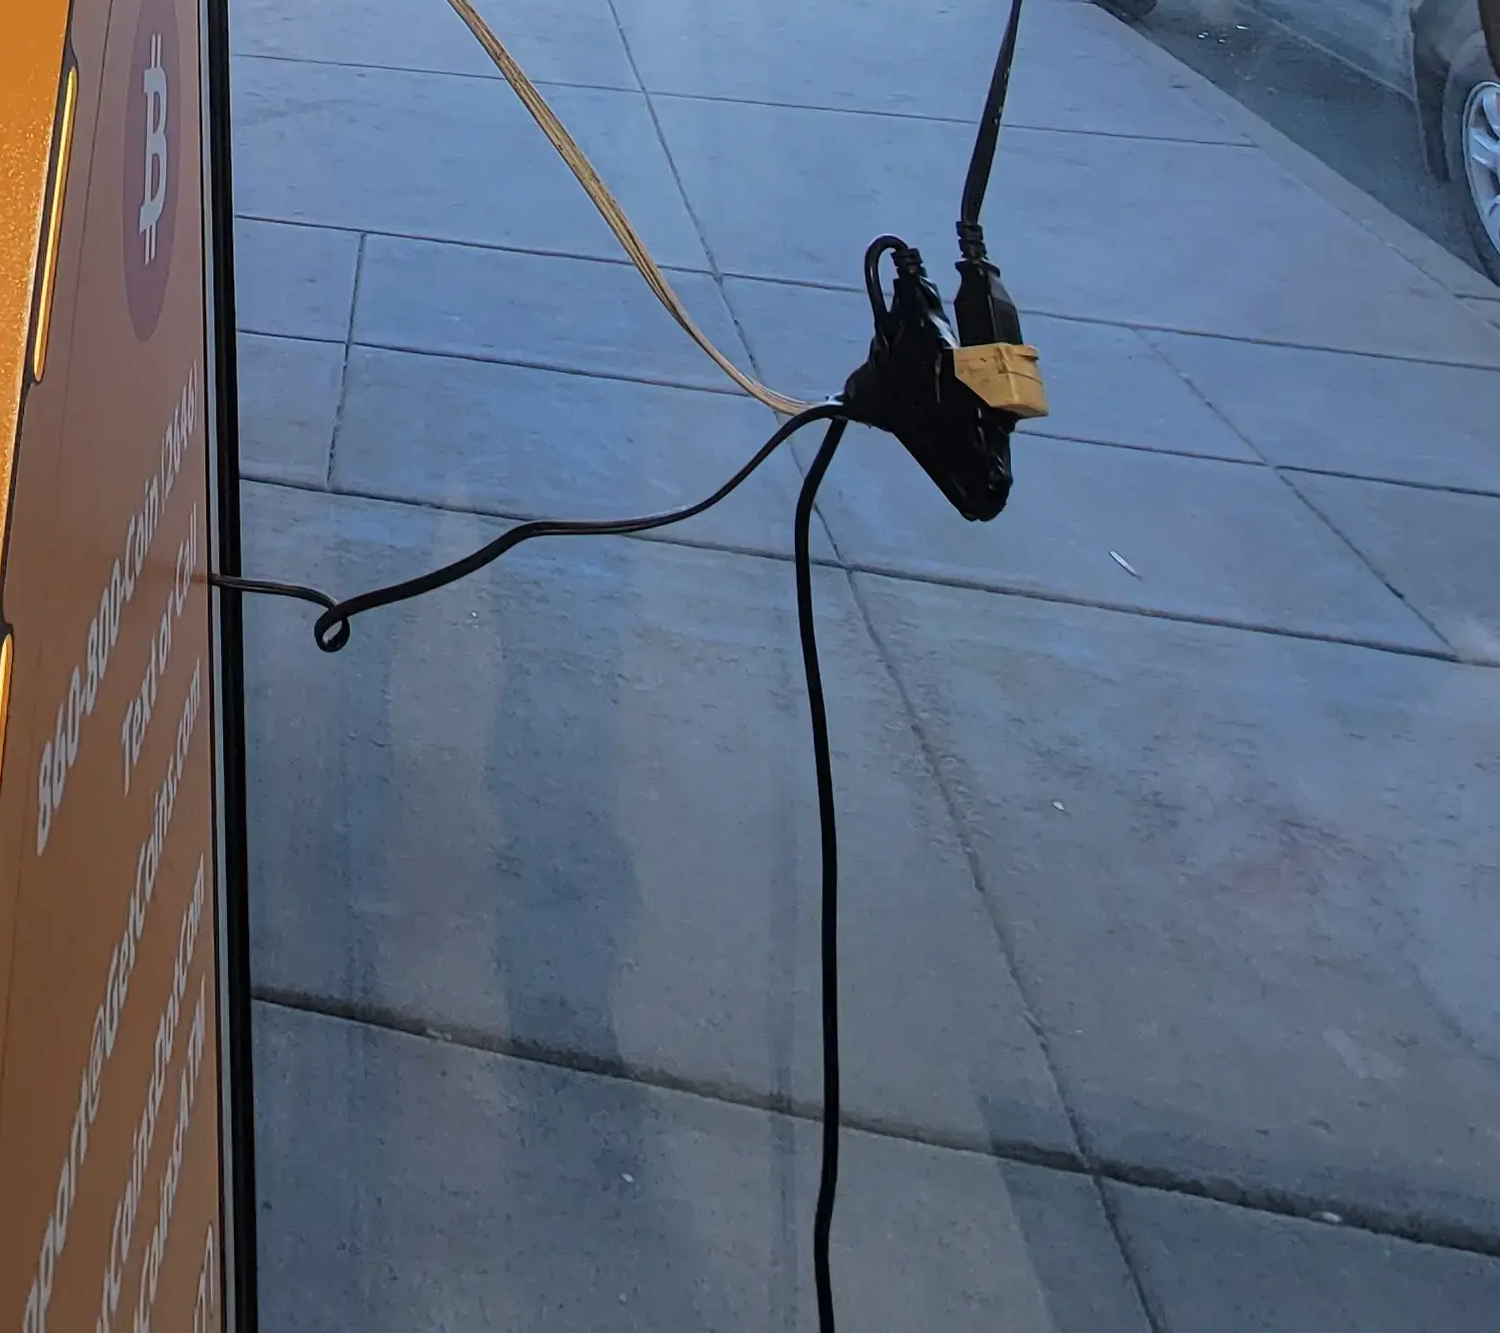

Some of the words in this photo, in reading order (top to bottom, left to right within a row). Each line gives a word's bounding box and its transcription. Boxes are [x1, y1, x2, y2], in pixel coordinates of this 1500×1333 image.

[37, 475, 159, 857] 860-800-Coin
[122, 637, 156, 796] Text
[159, 590, 174, 675] or
[175, 501, 197, 618] Call
